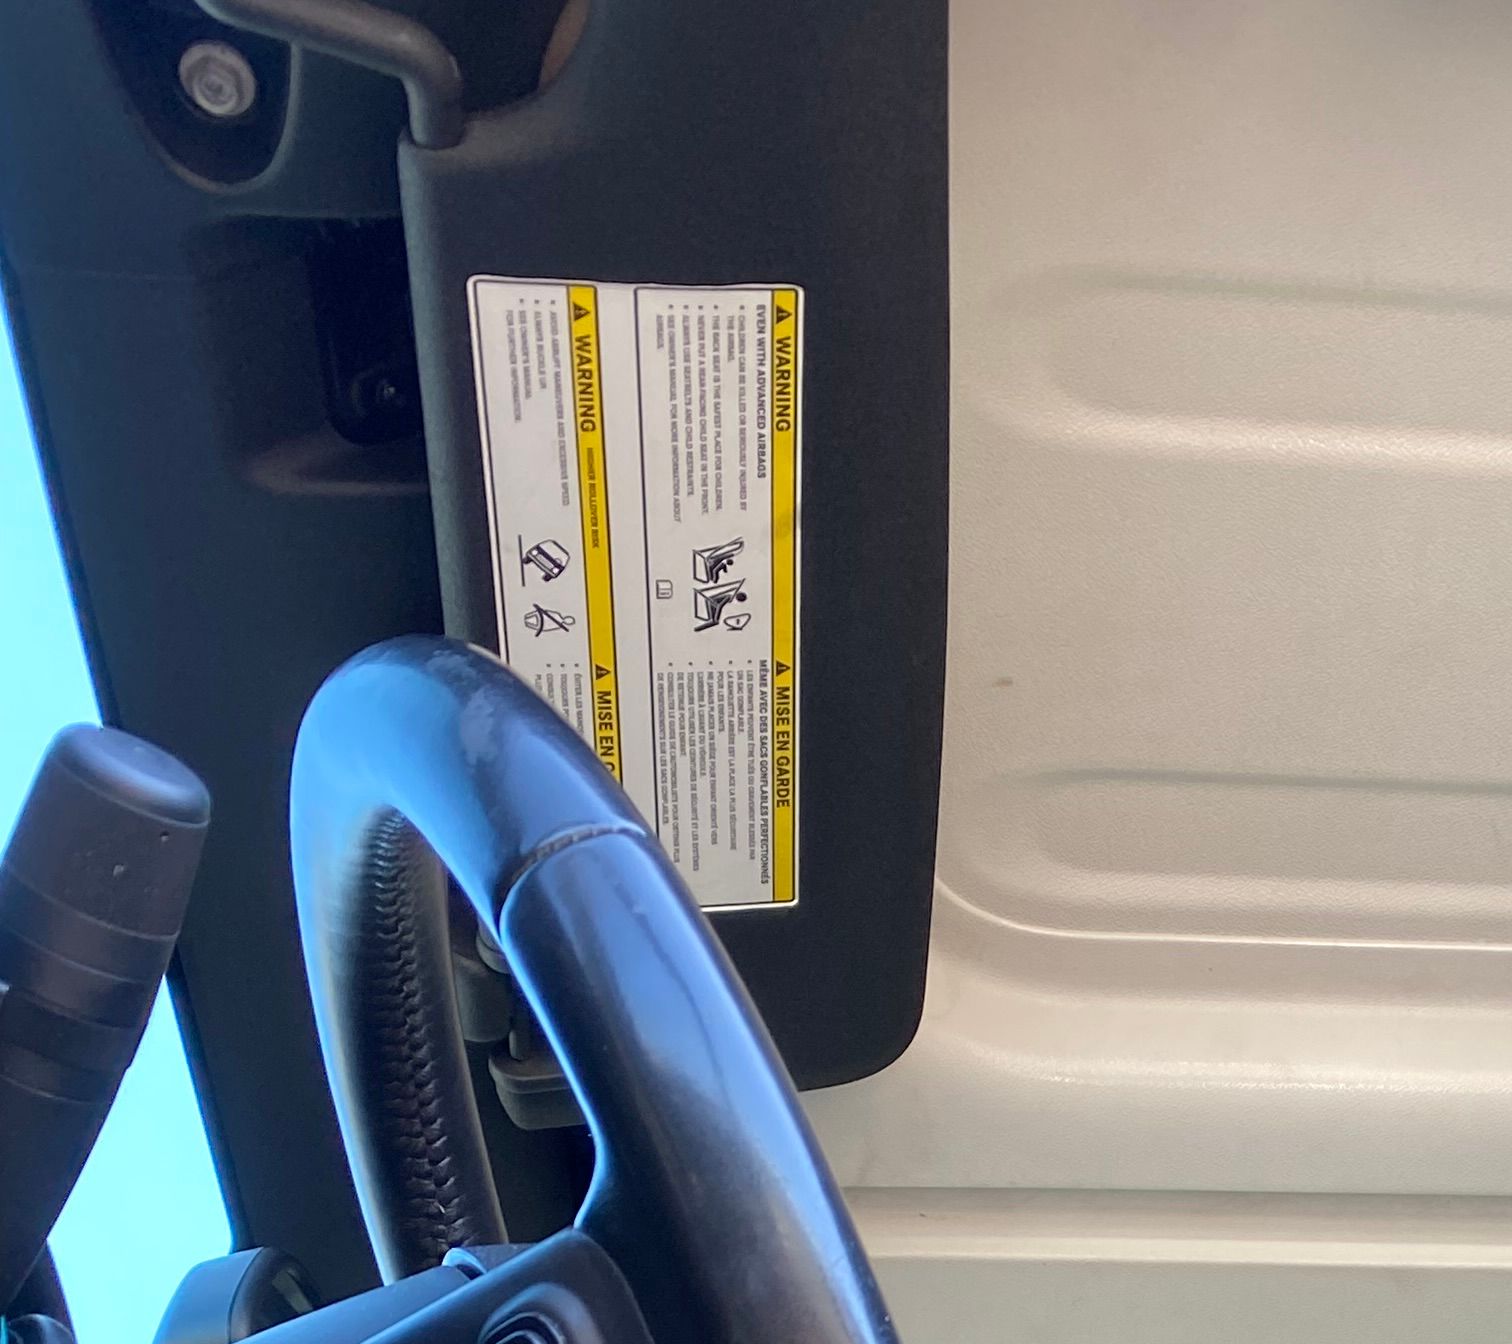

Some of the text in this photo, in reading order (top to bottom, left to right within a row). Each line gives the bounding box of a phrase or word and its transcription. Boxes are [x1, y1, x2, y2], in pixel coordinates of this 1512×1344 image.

[575, 335, 596, 433] WARNING
[757, 305, 766, 479] EVEN WITH ADVANCED AIRBAGS
[776, 336, 790, 432] WARNING
[597, 691, 613, 731] MISE
[600, 736, 614, 756] EN
[776, 687, 790, 808] MISE EN GARDE
[759, 659, 770, 884] MÊME AVEC DES SACS GONFLABLES PERFECTIONNÉS
